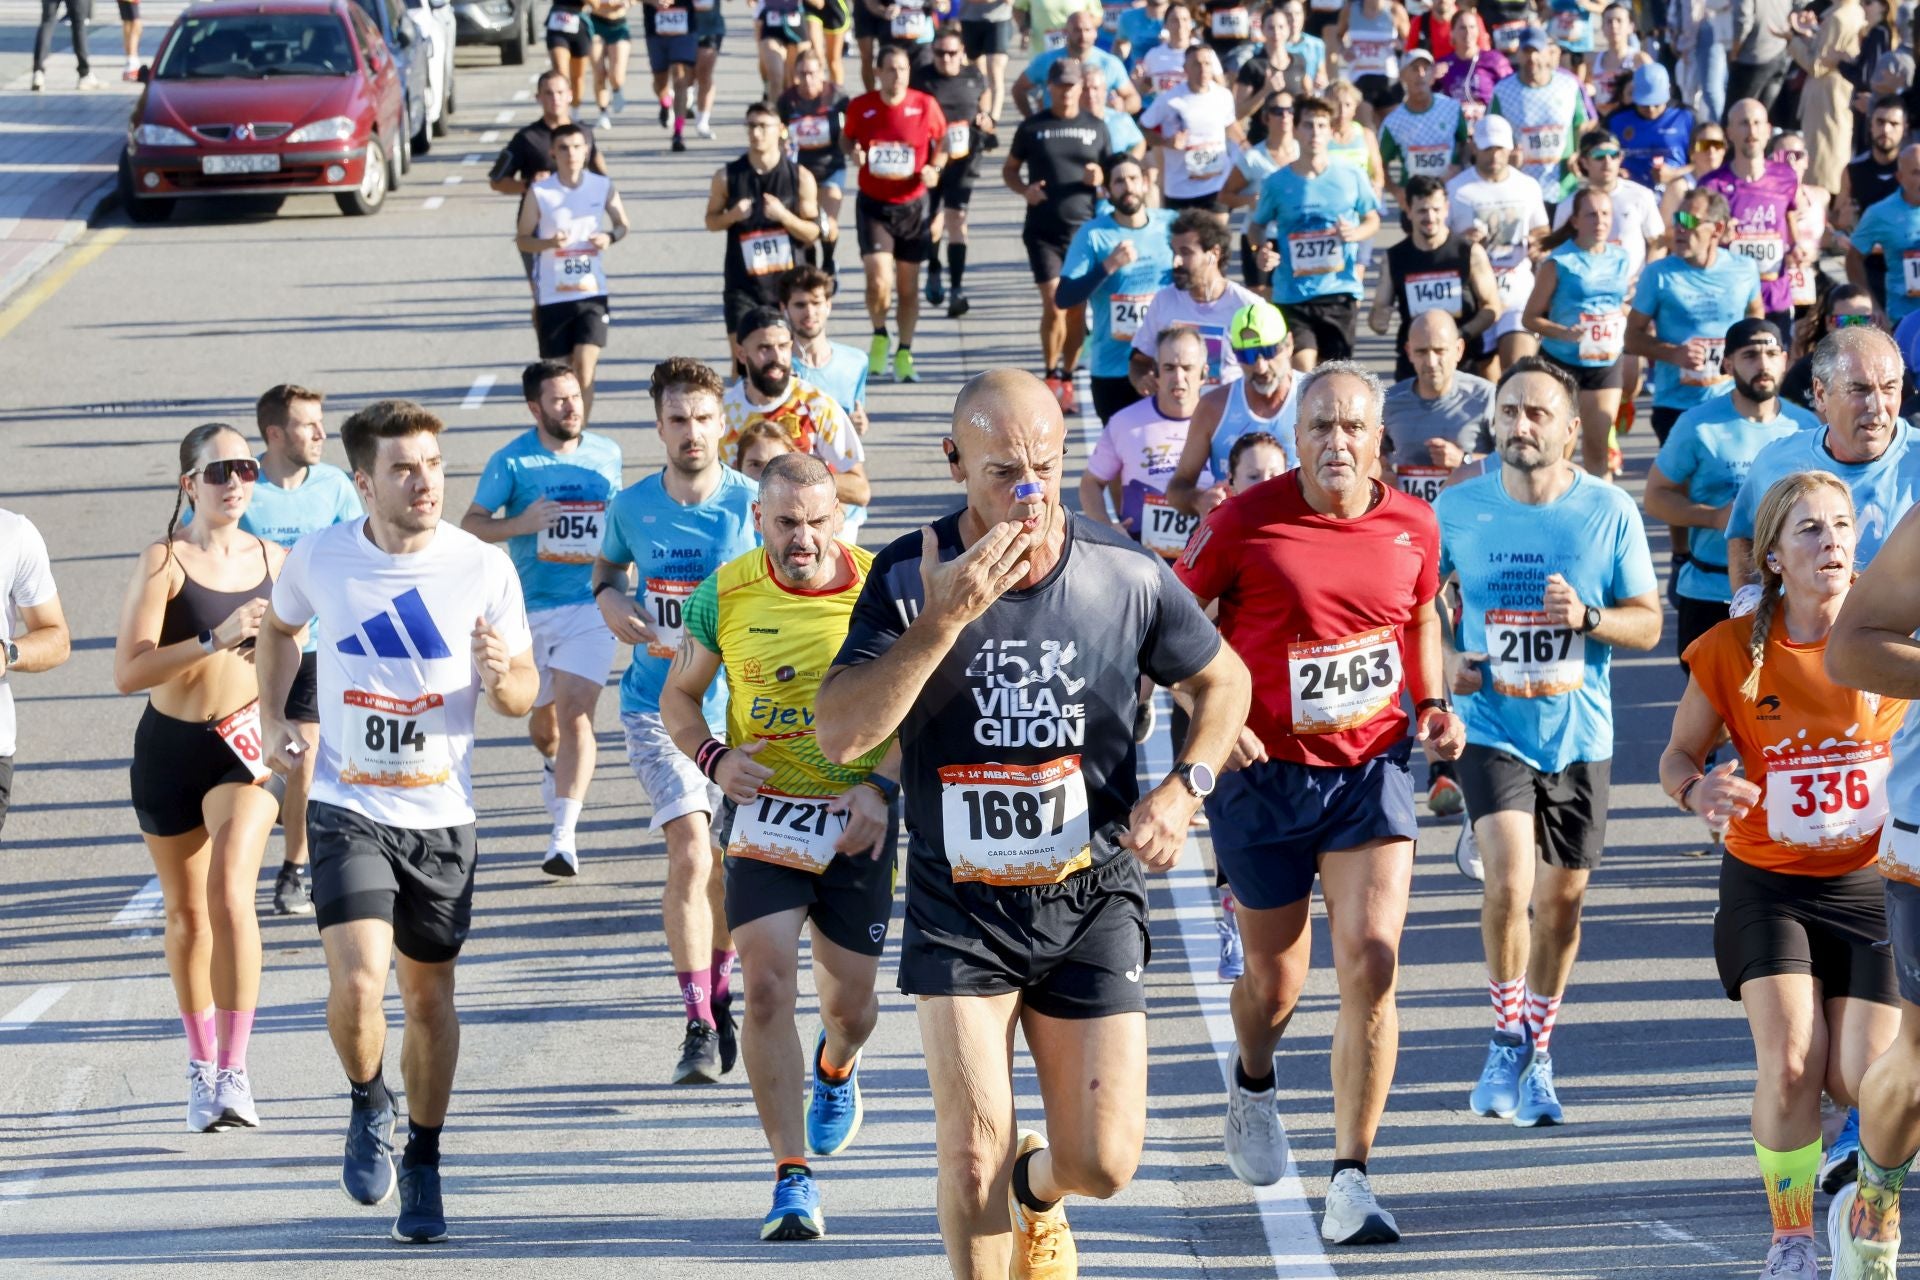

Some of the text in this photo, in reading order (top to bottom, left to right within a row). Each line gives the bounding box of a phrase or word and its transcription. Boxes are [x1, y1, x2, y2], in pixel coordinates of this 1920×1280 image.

[875, 150, 909, 164] 2329
[1415, 153, 1445, 168] 1505
[753, 239, 778, 256] 861
[1296, 238, 1336, 258] 2372
[1739, 243, 1776, 260] 1690
[565, 259, 591, 274] 859
[1414, 281, 1452, 302] 1401
[548, 515, 598, 539] 1054
[1153, 509, 1200, 535] 1782
[671, 548, 702, 559] MBA
[1510, 552, 1544, 563] MBA
[664, 562, 704, 574] media
[1501, 567, 1545, 581] media
[655, 597, 685, 629] 10
[1500, 629, 1574, 663] 2167
[965, 638, 1031, 689] 45
[1299, 648, 1394, 701] 2463
[751, 696, 816, 729] Ejev
[971, 687, 1086, 718] VILLA DE
[365, 714, 426, 754] 814
[973, 716, 1086, 748] GIJÓN
[1801, 755, 1826, 765] MBA
[983, 770, 1011, 780] MBA
[1031, 766, 1061, 781] GIJÓN
[1790, 769, 1870, 818] 336
[757, 794, 831, 837] 1721
[962, 783, 1067, 841] 1687
[987, 846, 1056, 857] CARLOS ANDRADE
